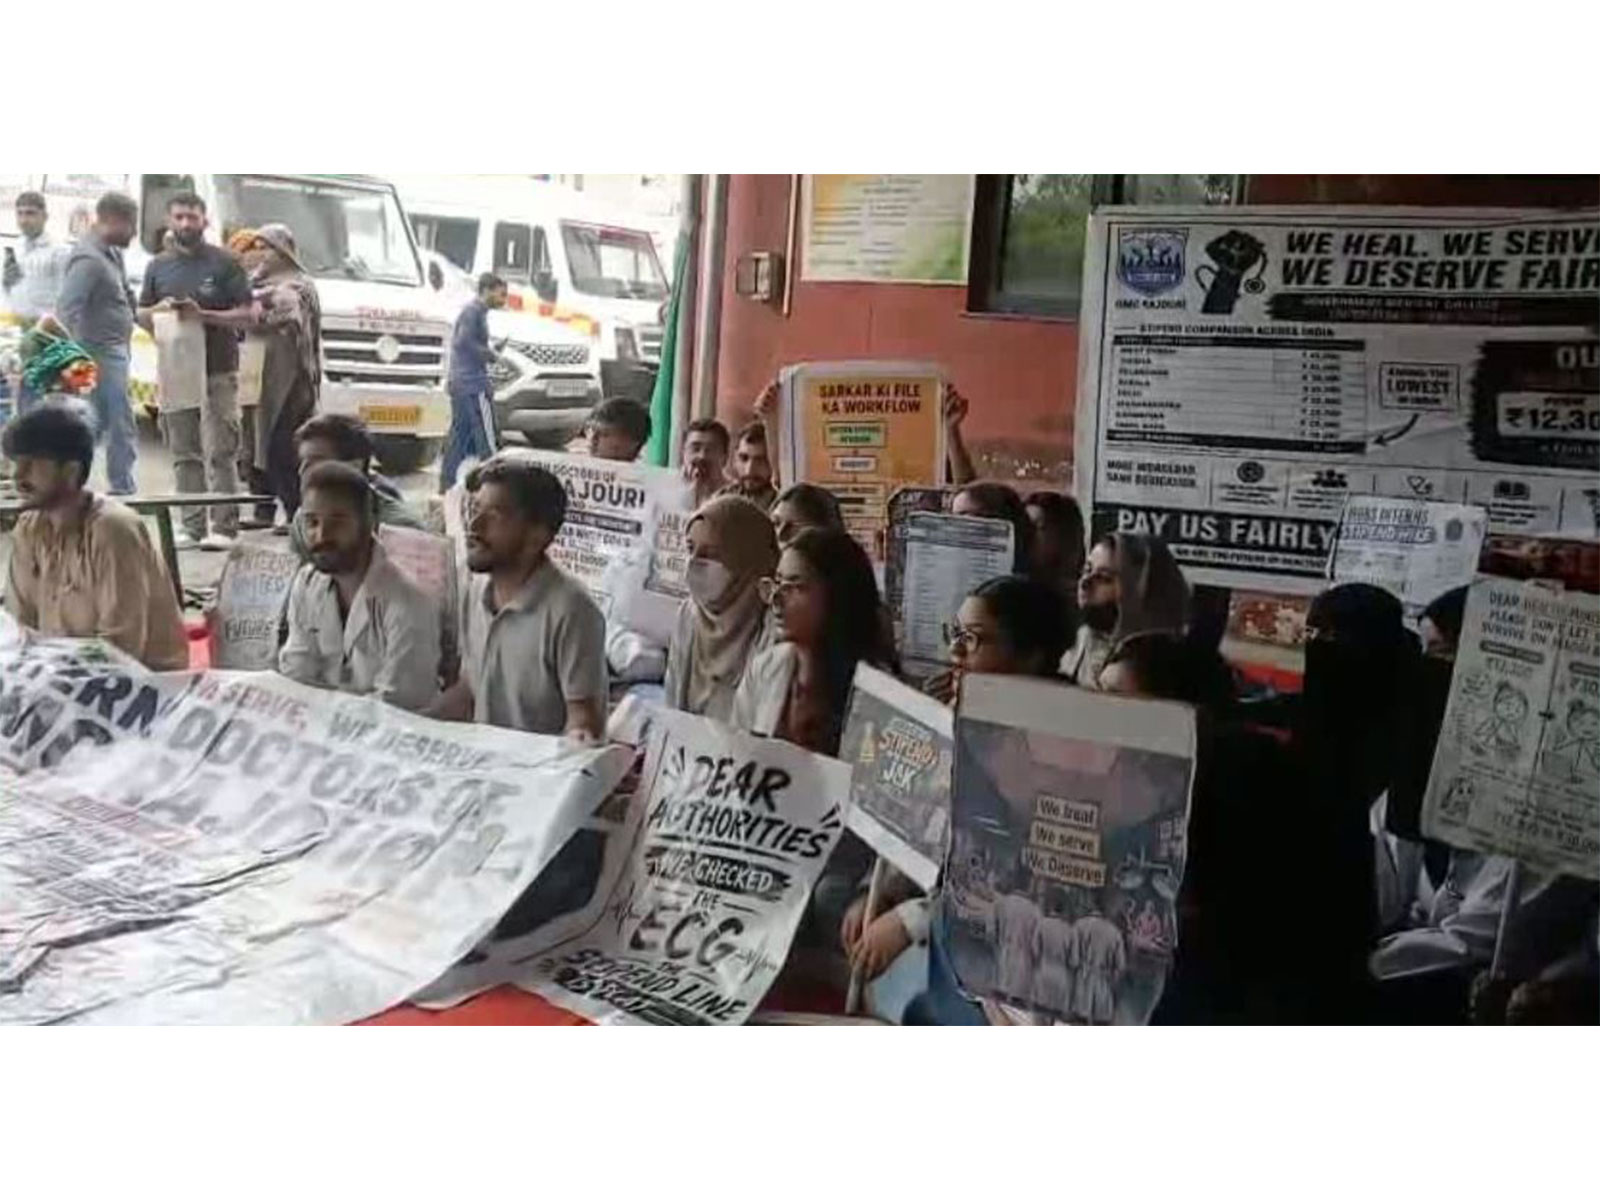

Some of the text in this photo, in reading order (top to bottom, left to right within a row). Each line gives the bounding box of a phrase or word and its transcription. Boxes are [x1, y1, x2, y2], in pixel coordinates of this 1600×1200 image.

[1287, 228, 1600, 257] WE HEAL. WE SERV
[1282, 257, 1334, 286] WE
[1345, 259, 1508, 289] DESERVE
[819, 384, 921, 398] SARKAR KI FILE
[1387, 380, 1451, 394] LOWEST
[821, 400, 921, 415] KA WORKFLOW
[564, 479, 645, 508] AJOURI
[1118, 509, 1338, 552] PAY US FAIRLY
[695, 754, 791, 813] DEAR
[1040, 799, 1060, 817] We
[648, 797, 829, 858] AUTHORITIES
[1036, 823, 1095, 851] We serve
[693, 853, 774, 893] CHECKED
[1047, 856, 1102, 885] Deserve
[692, 889, 721, 909] THE
[630, 902, 745, 967] ECG
[671, 983, 748, 1022] LINE
